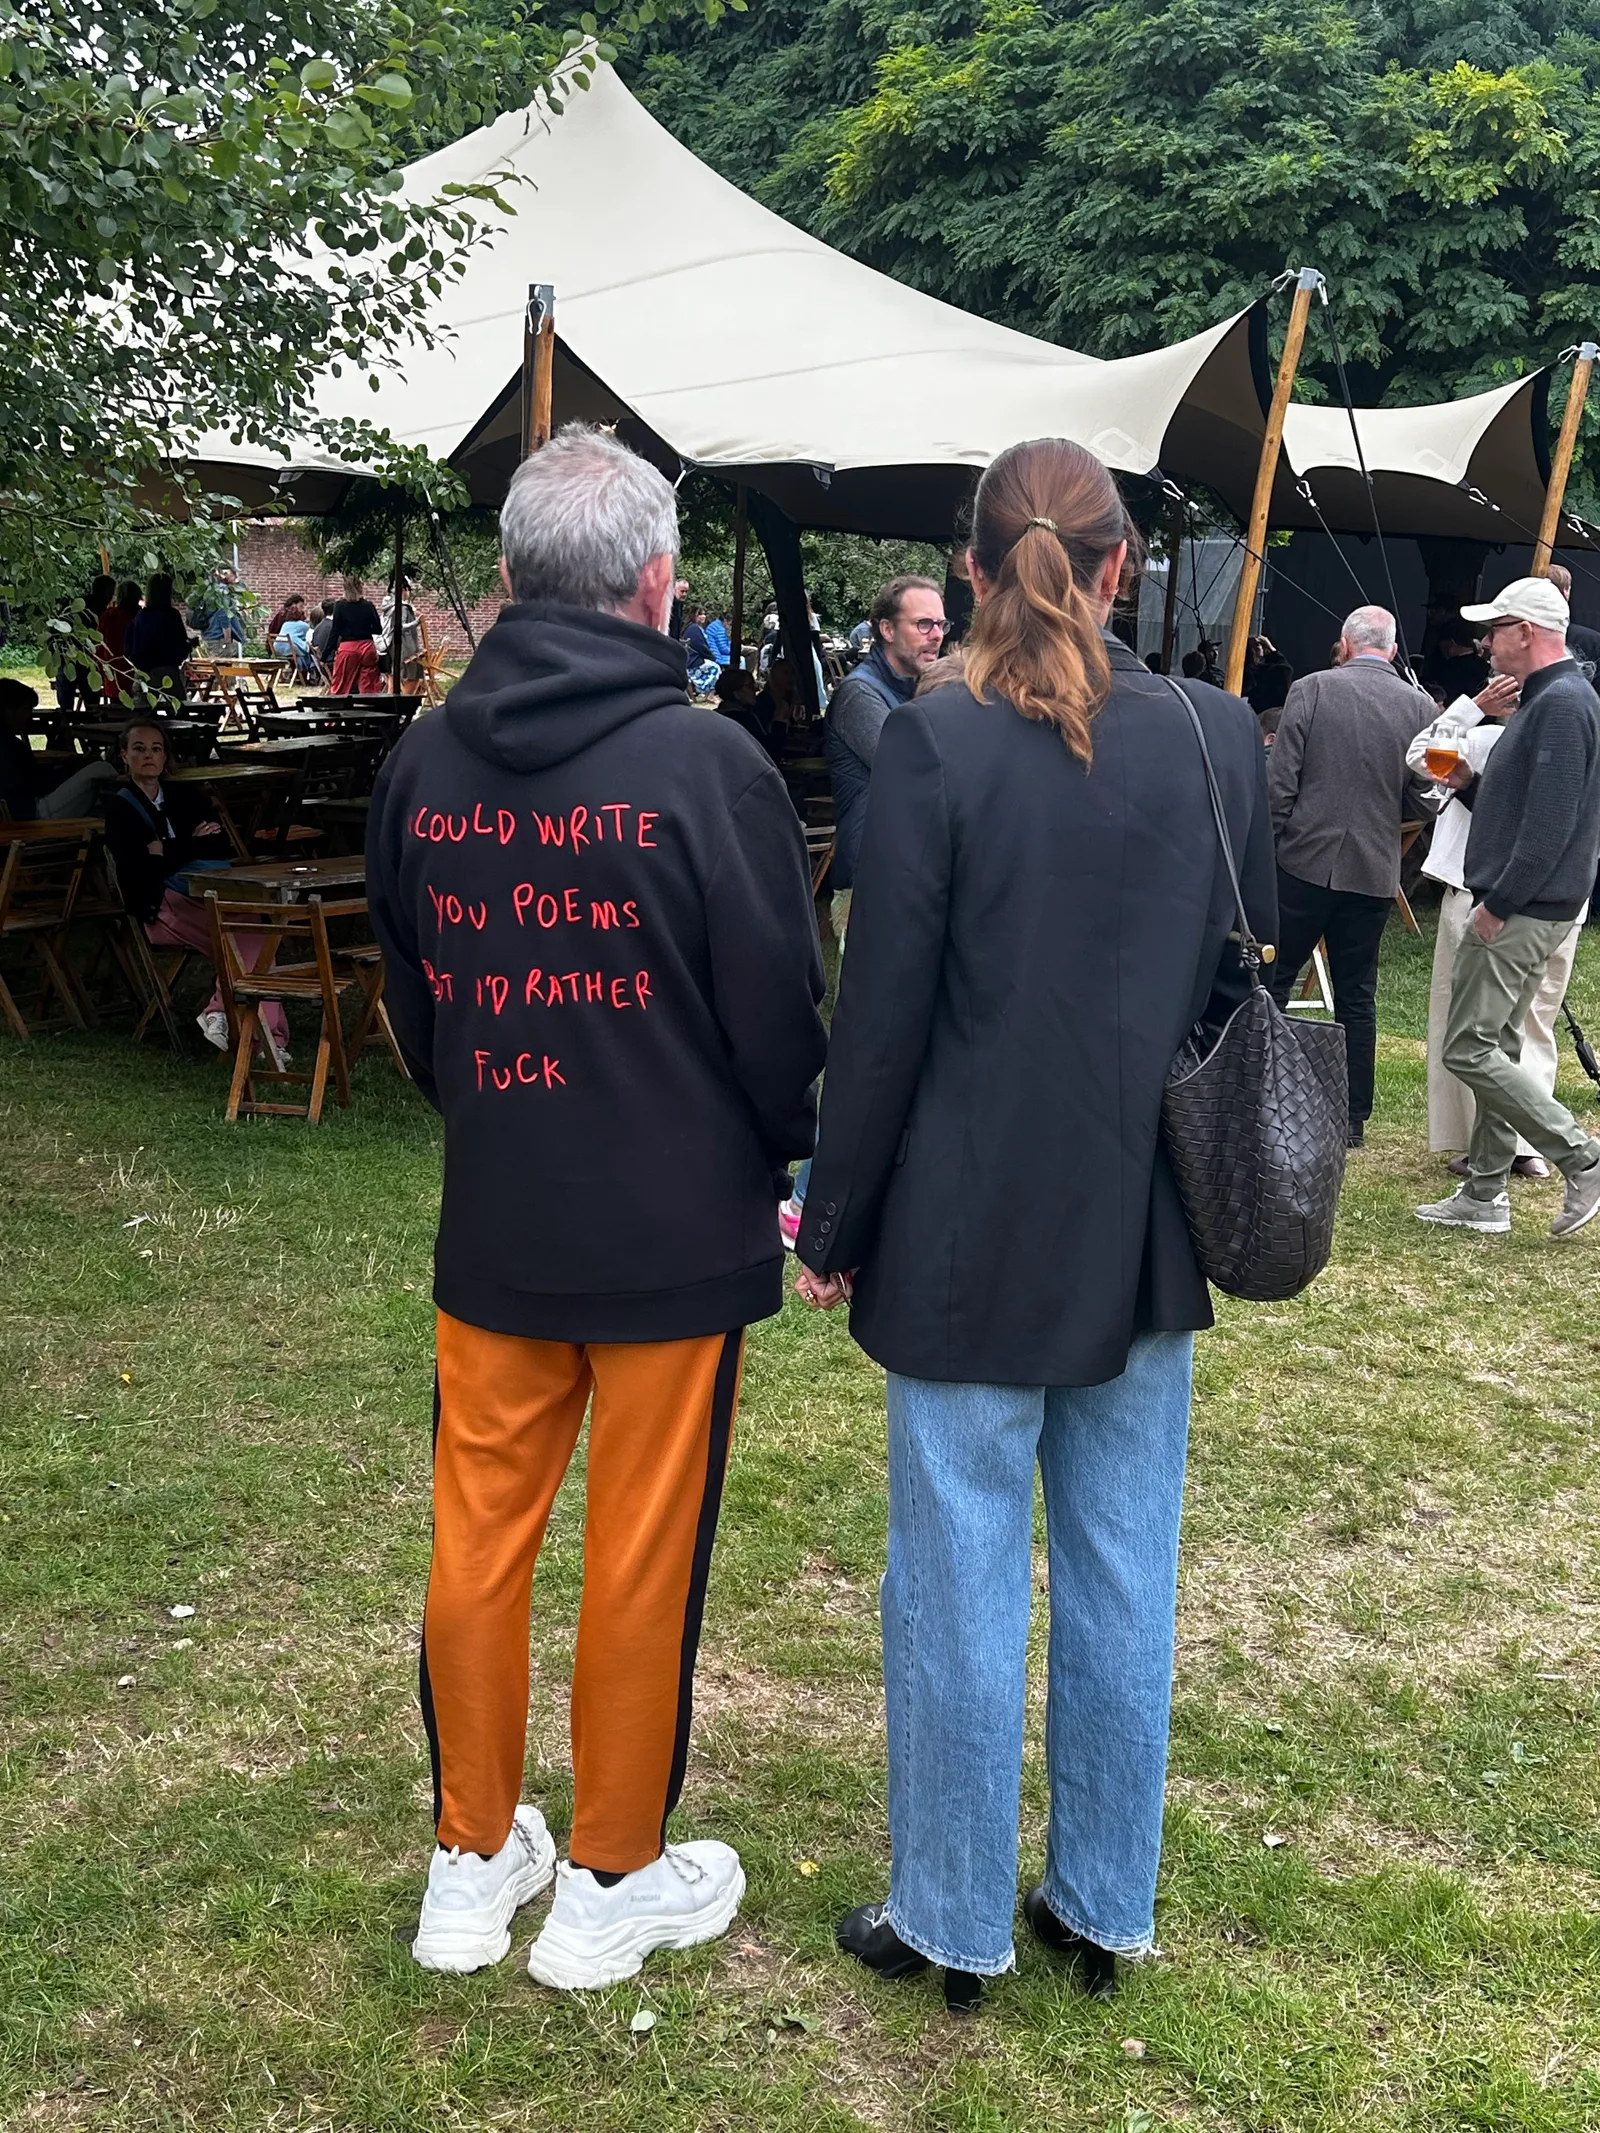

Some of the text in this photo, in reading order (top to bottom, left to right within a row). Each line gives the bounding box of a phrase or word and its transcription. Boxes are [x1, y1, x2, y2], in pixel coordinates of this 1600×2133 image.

[414, 803, 516, 844] COULD
[532, 804, 658, 856] WRITE
[428, 882, 640, 934] YOU POEMS
[476, 975, 509, 1015] I'D
[525, 968, 652, 1010] RATHER
[474, 1050, 566, 1091] FUCK
